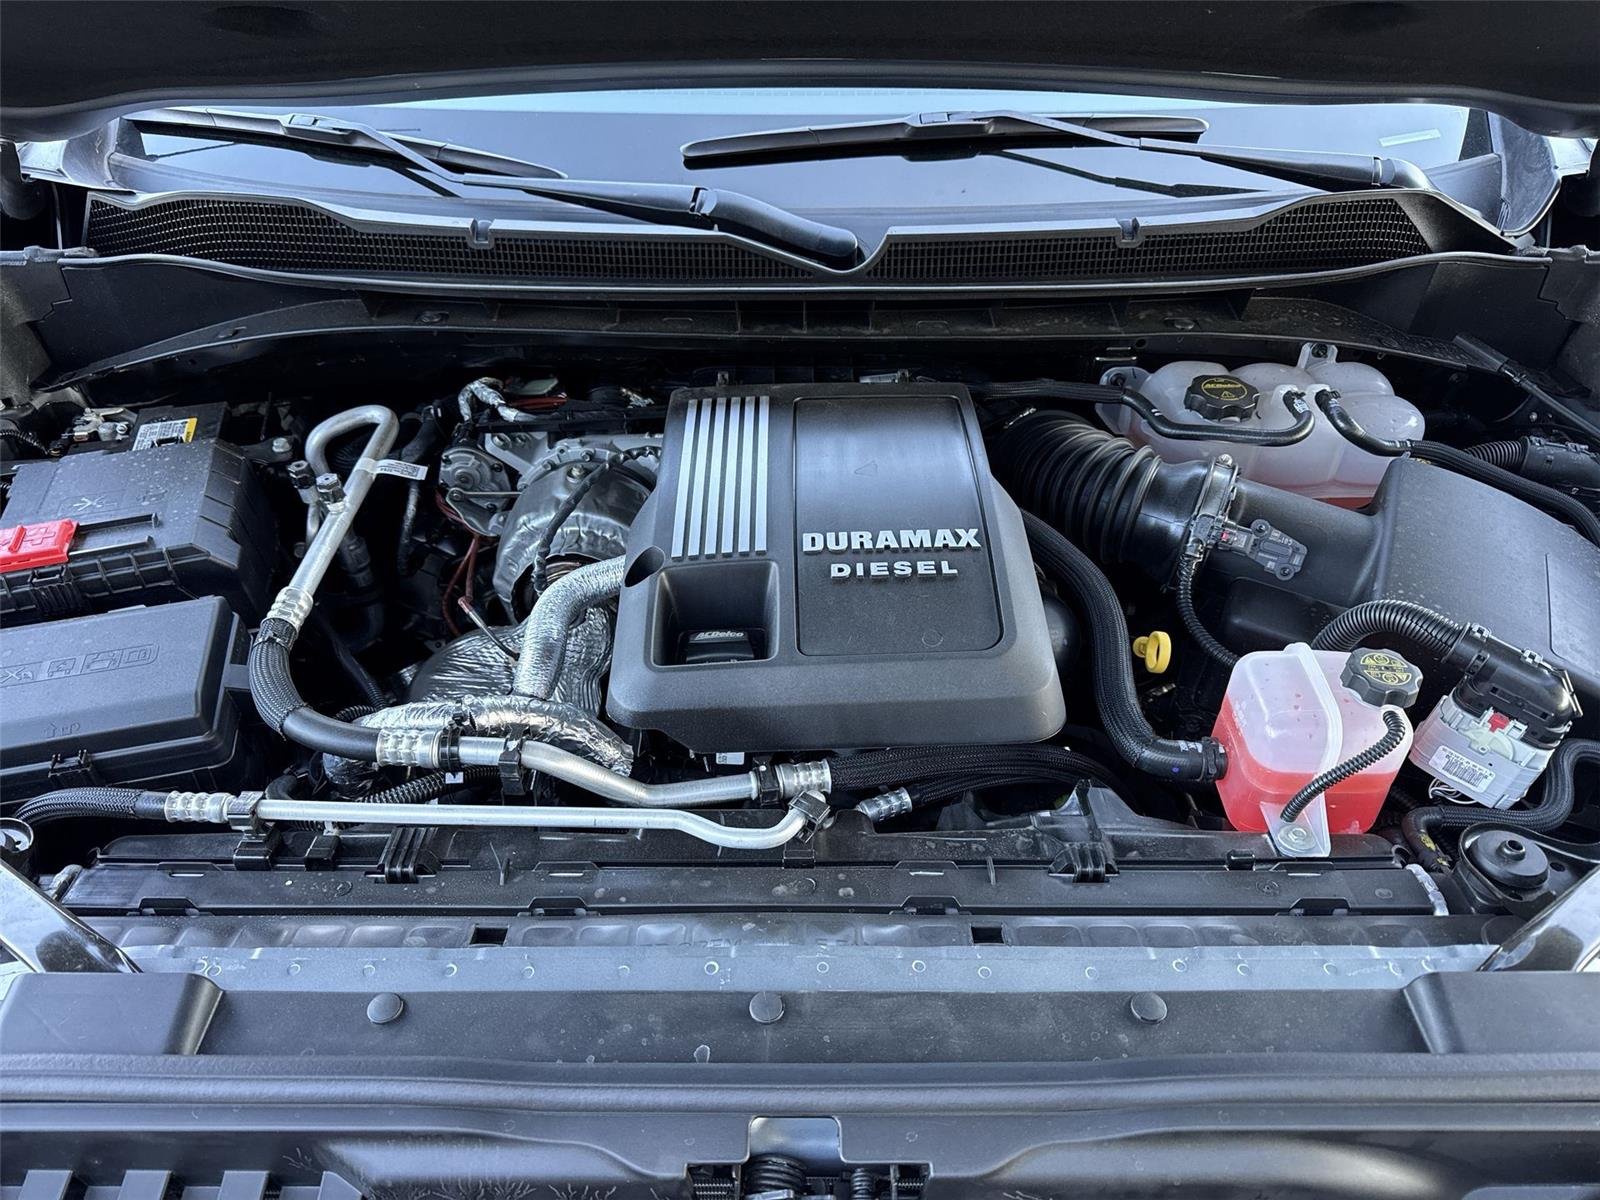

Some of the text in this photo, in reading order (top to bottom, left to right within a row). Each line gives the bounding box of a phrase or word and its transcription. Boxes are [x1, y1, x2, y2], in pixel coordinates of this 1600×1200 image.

[802, 528, 981, 552] DURAMAX
[830, 561, 959, 579] DIESEL
[694, 631, 744, 640] ACDelco
